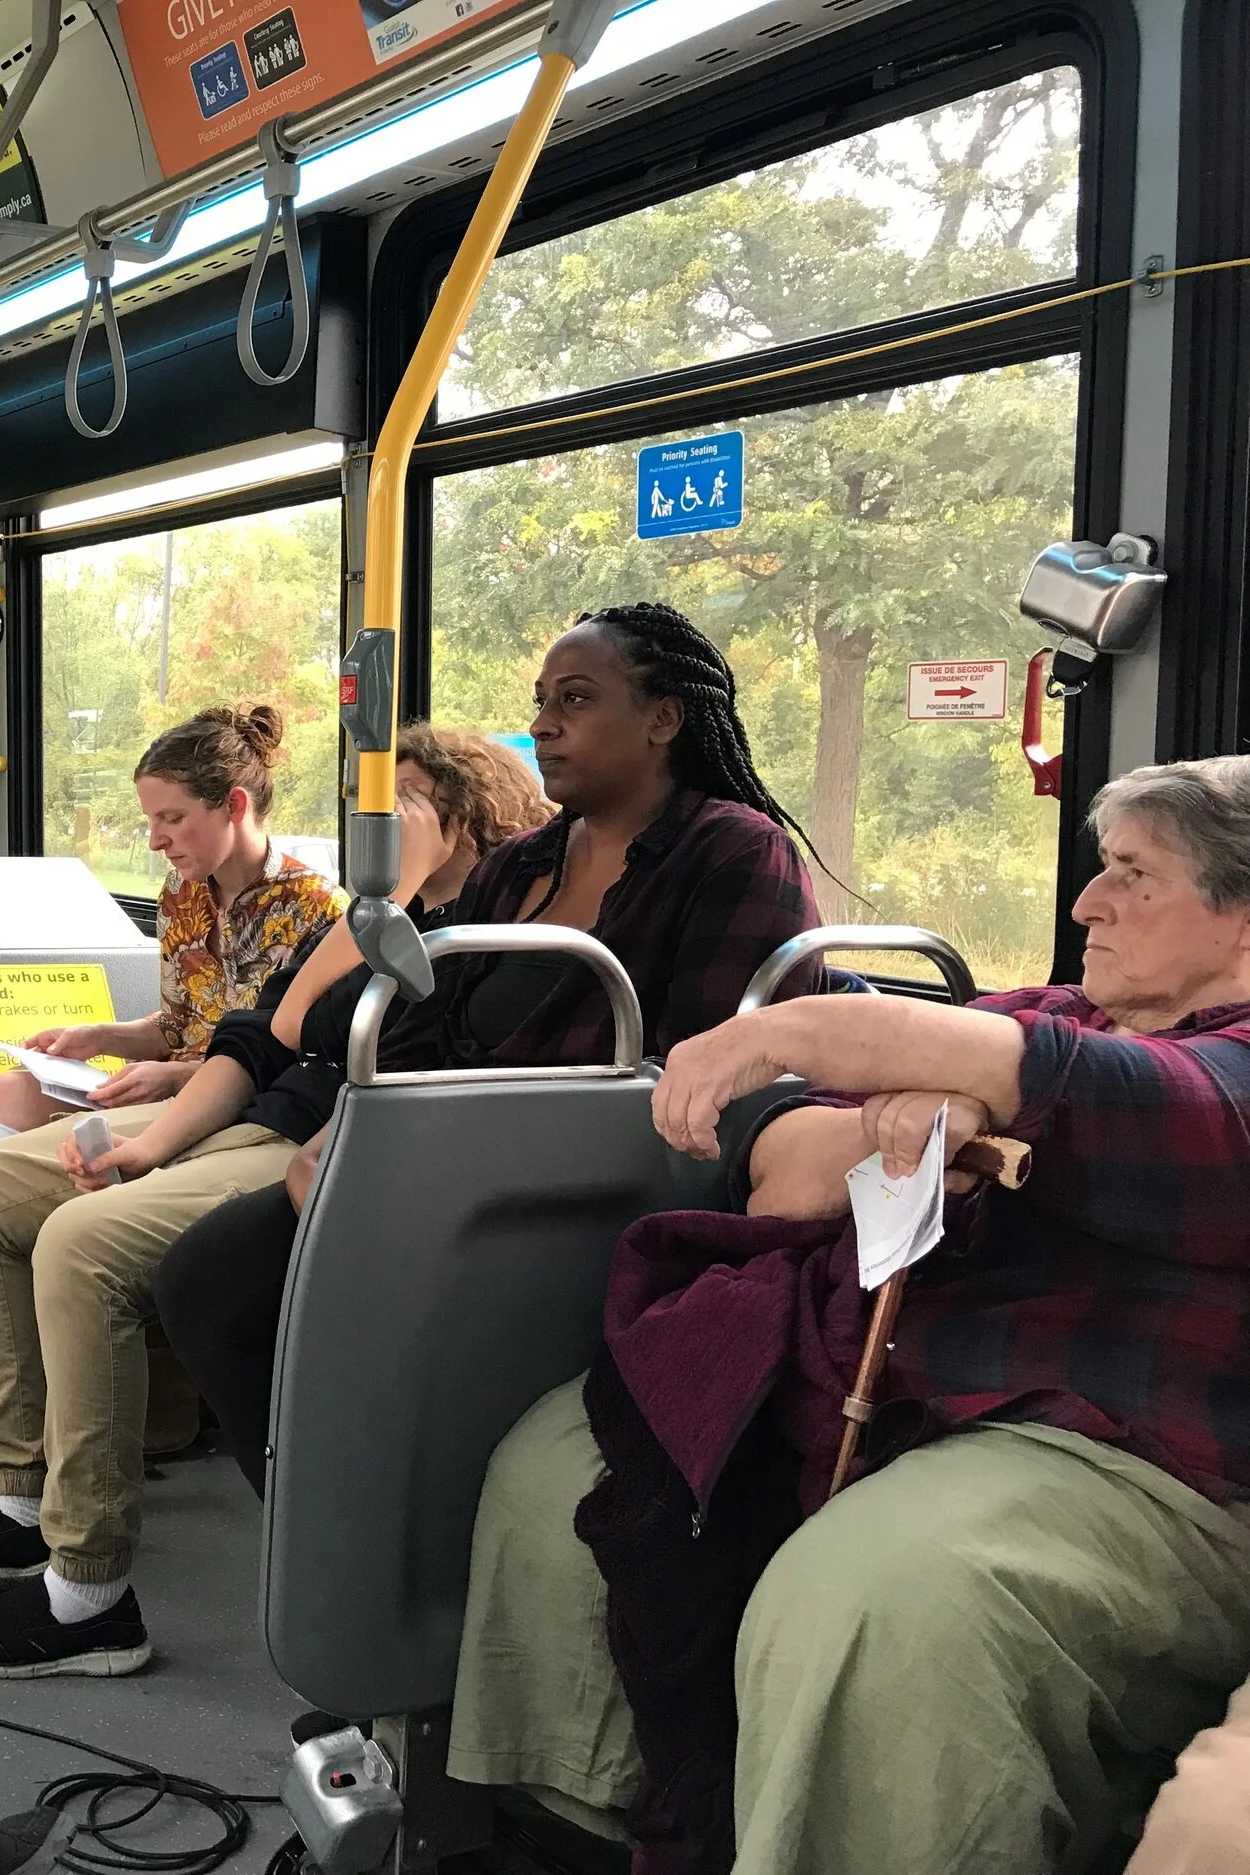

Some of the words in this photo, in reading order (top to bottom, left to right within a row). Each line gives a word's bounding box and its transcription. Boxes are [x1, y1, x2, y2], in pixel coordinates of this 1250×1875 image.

[164, 52, 183, 68] These
[183, 43, 199, 56] seats
[199, 38, 209, 50] are
[209, 30, 219, 41] for
[219, 19, 238, 36] those
[238, 9, 253, 23] who
[376, 22, 410, 50] Transit
[197, 129, 220, 144] Please
[220, 116, 237, 133] read
[237, 108, 250, 125] and
[251, 96, 280, 120] respect
[280, 85, 301, 102] these
[301, 72, 325, 92] signs.
[661, 449, 688, 462] Priority
[690, 445, 718, 456] Seating
[957, 665, 994, 673] SECOURS
[8, 971, 42, 983] who
[48, 972, 75, 982] use
[81, 971, 89, 982] a
[43, 1005, 58, 1015] or
[63, 1002, 94, 1015] turn
